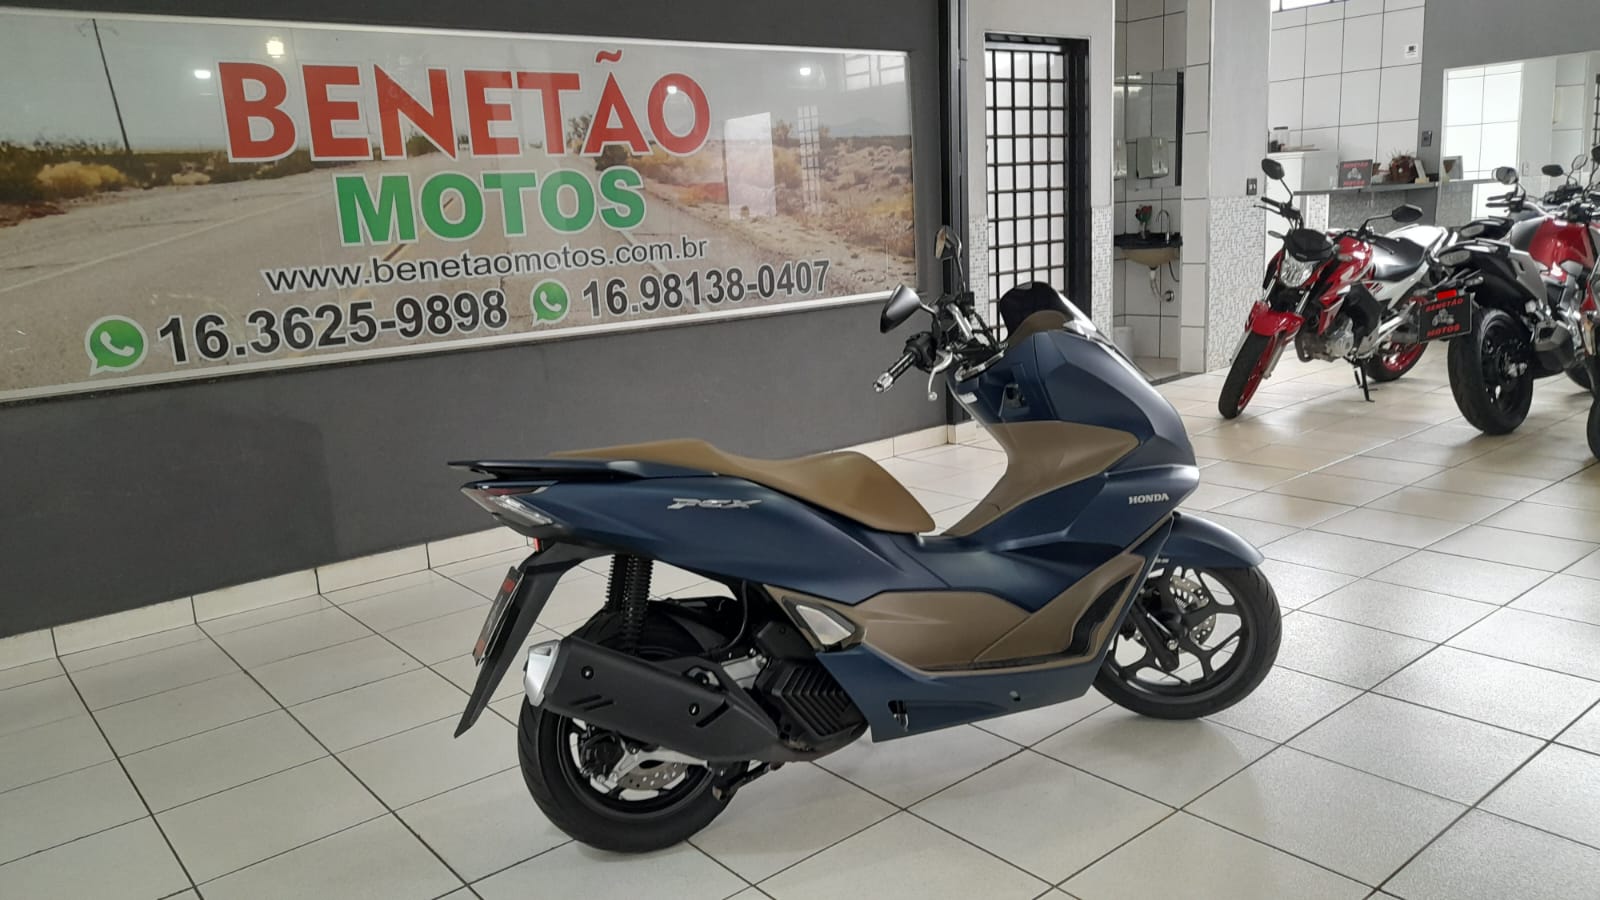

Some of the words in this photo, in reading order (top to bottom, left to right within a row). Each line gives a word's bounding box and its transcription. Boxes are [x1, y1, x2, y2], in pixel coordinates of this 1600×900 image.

[217, 49, 711, 161] BENETÃO
[336, 169, 646, 246] MOTOS
[266, 237, 708, 290] www.benetaomotos.com.br
[583, 260, 830, 316] 16.98138-0407
[160, 290, 507, 362] 16.3625-9898
[667, 497, 762, 509] PCX
[1128, 493, 1170, 505] HONDA
